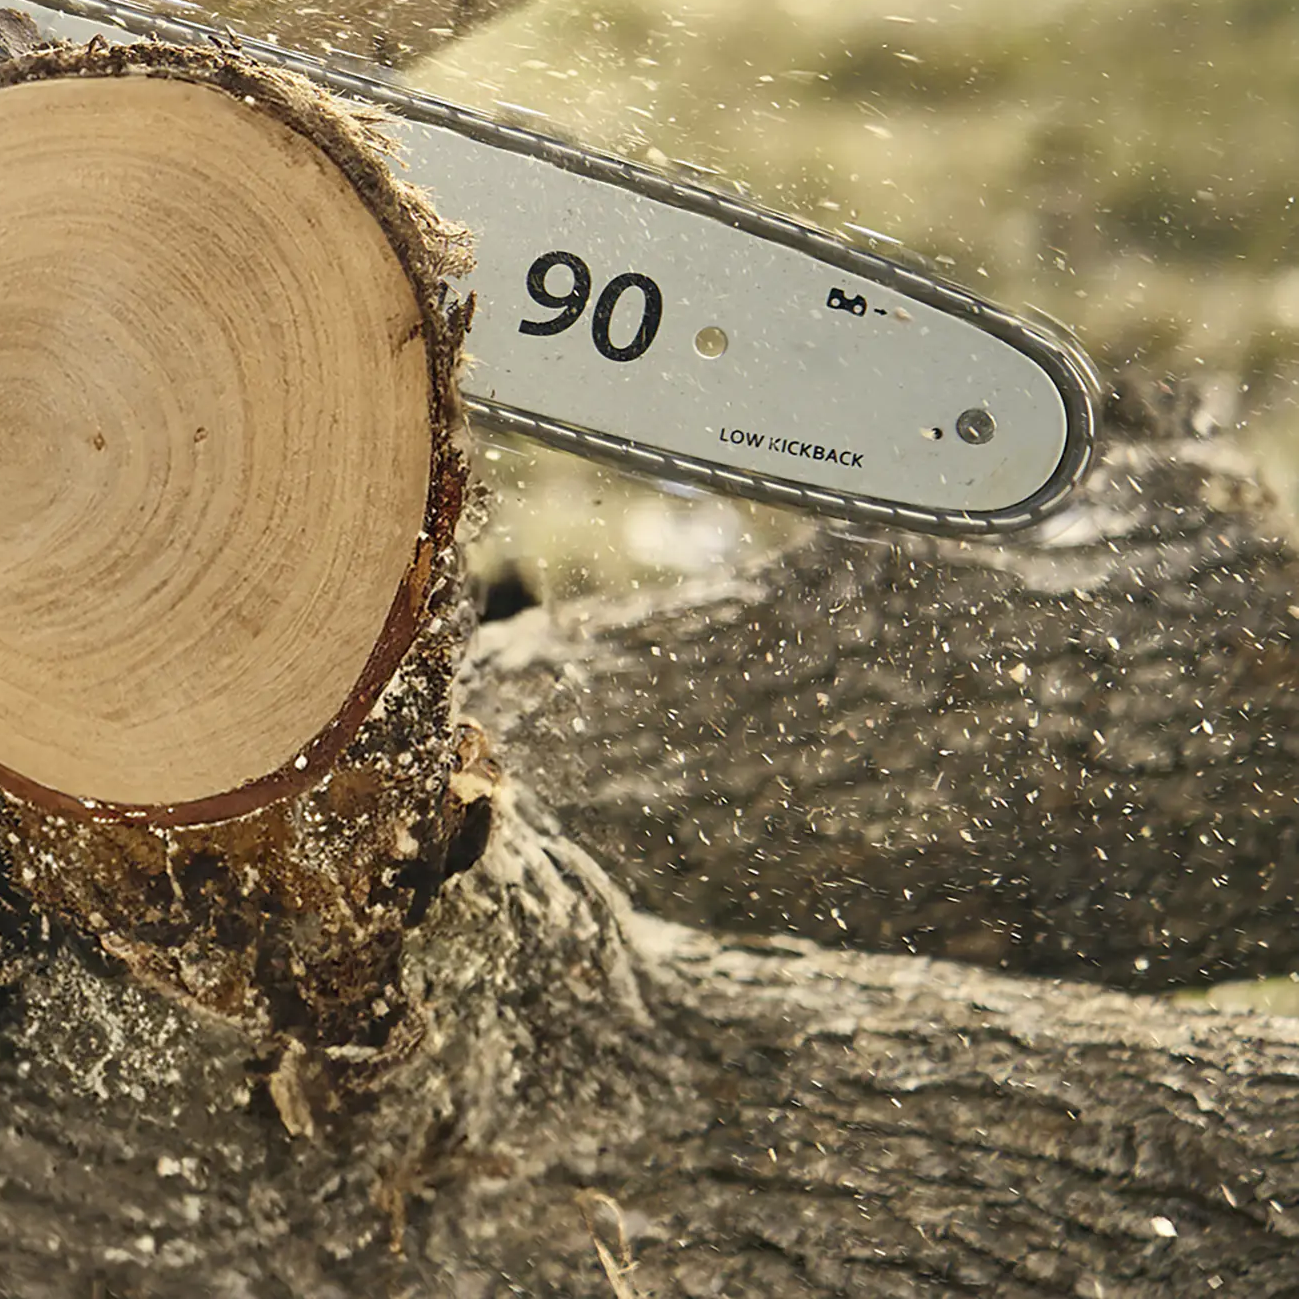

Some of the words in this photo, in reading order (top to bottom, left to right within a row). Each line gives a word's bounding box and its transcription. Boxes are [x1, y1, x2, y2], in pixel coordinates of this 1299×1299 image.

[518, 250, 663, 363] 90
[719, 427, 765, 448] LOW
[768, 437, 864, 468] KICKBACK
